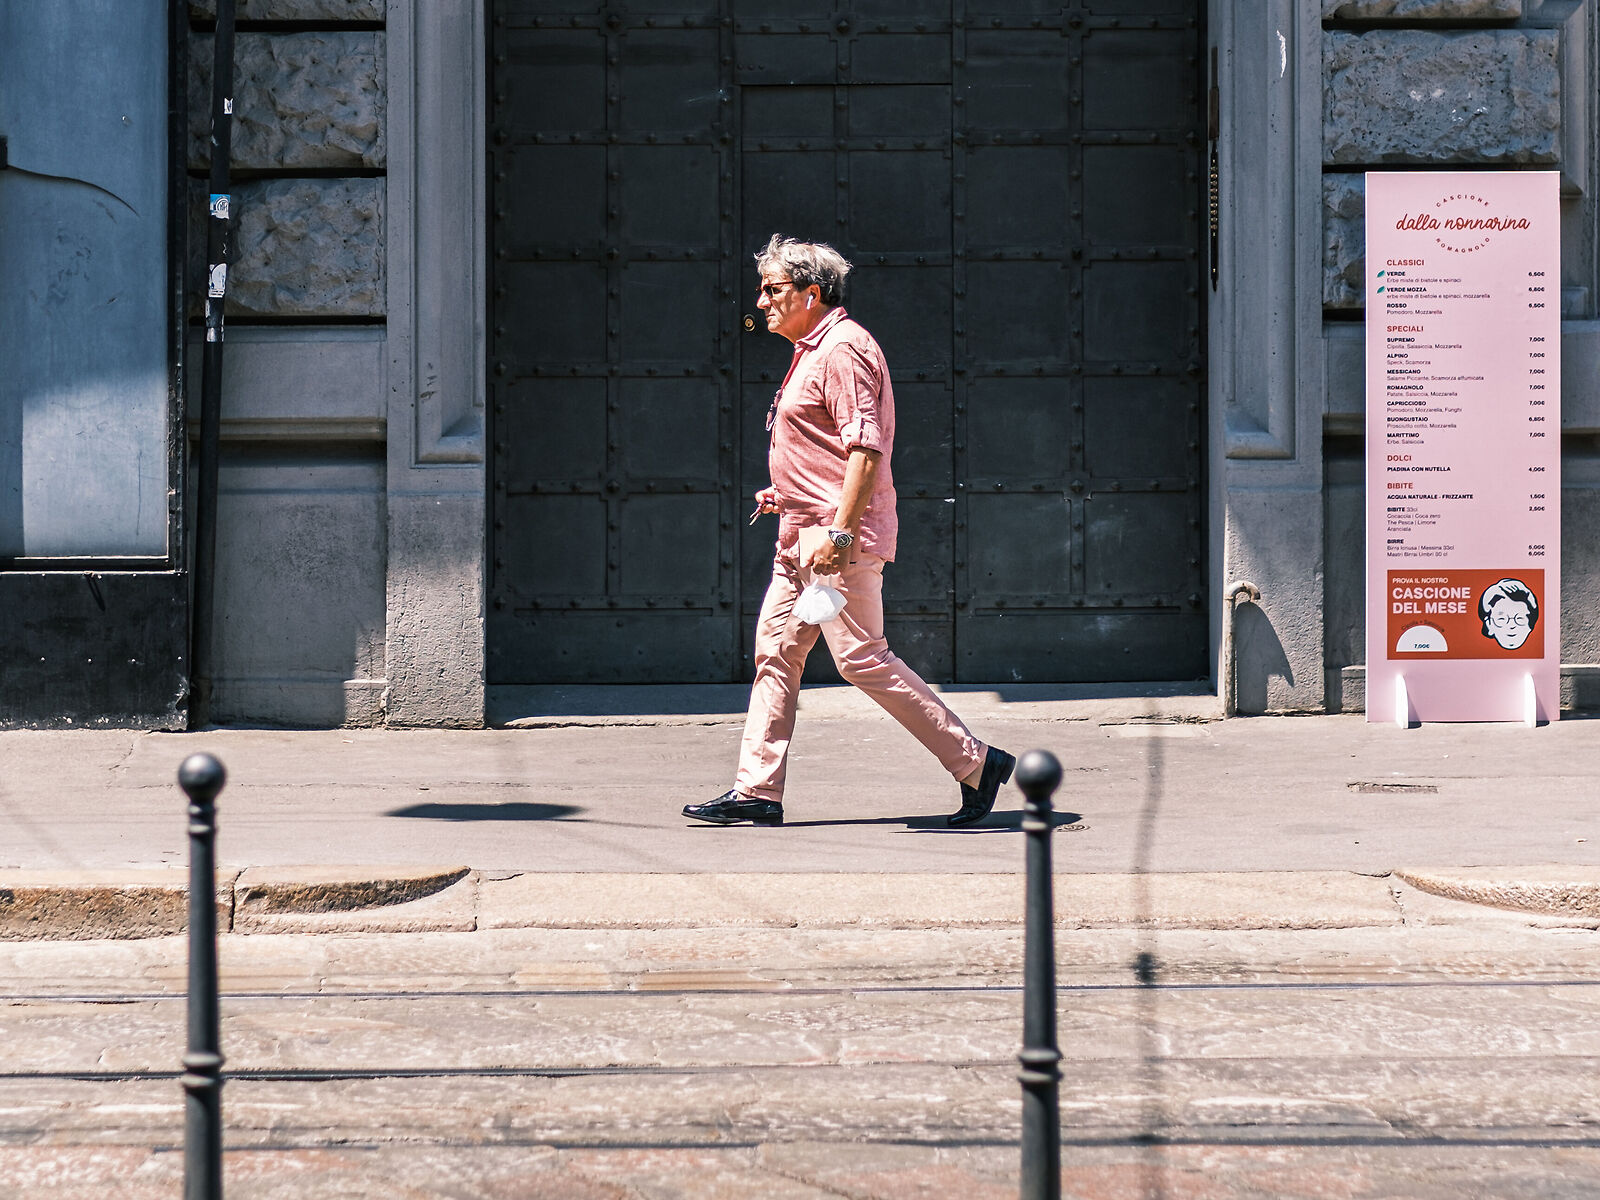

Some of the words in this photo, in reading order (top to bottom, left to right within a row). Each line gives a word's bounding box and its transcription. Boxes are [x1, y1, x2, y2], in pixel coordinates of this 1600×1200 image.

[1436, 194, 1490, 208] CASCIONE
[1396, 213, 1442, 231] dalla
[1444, 214, 1531, 232] nonnarina
[1436, 236, 1490, 253] ROMAGNOLO
[1386, 259, 1425, 267] CLASSICI
[1392, 587, 1471, 599] CASCIONE
[1392, 602, 1421, 614] DEL
[1425, 602, 1467, 614] MESE
